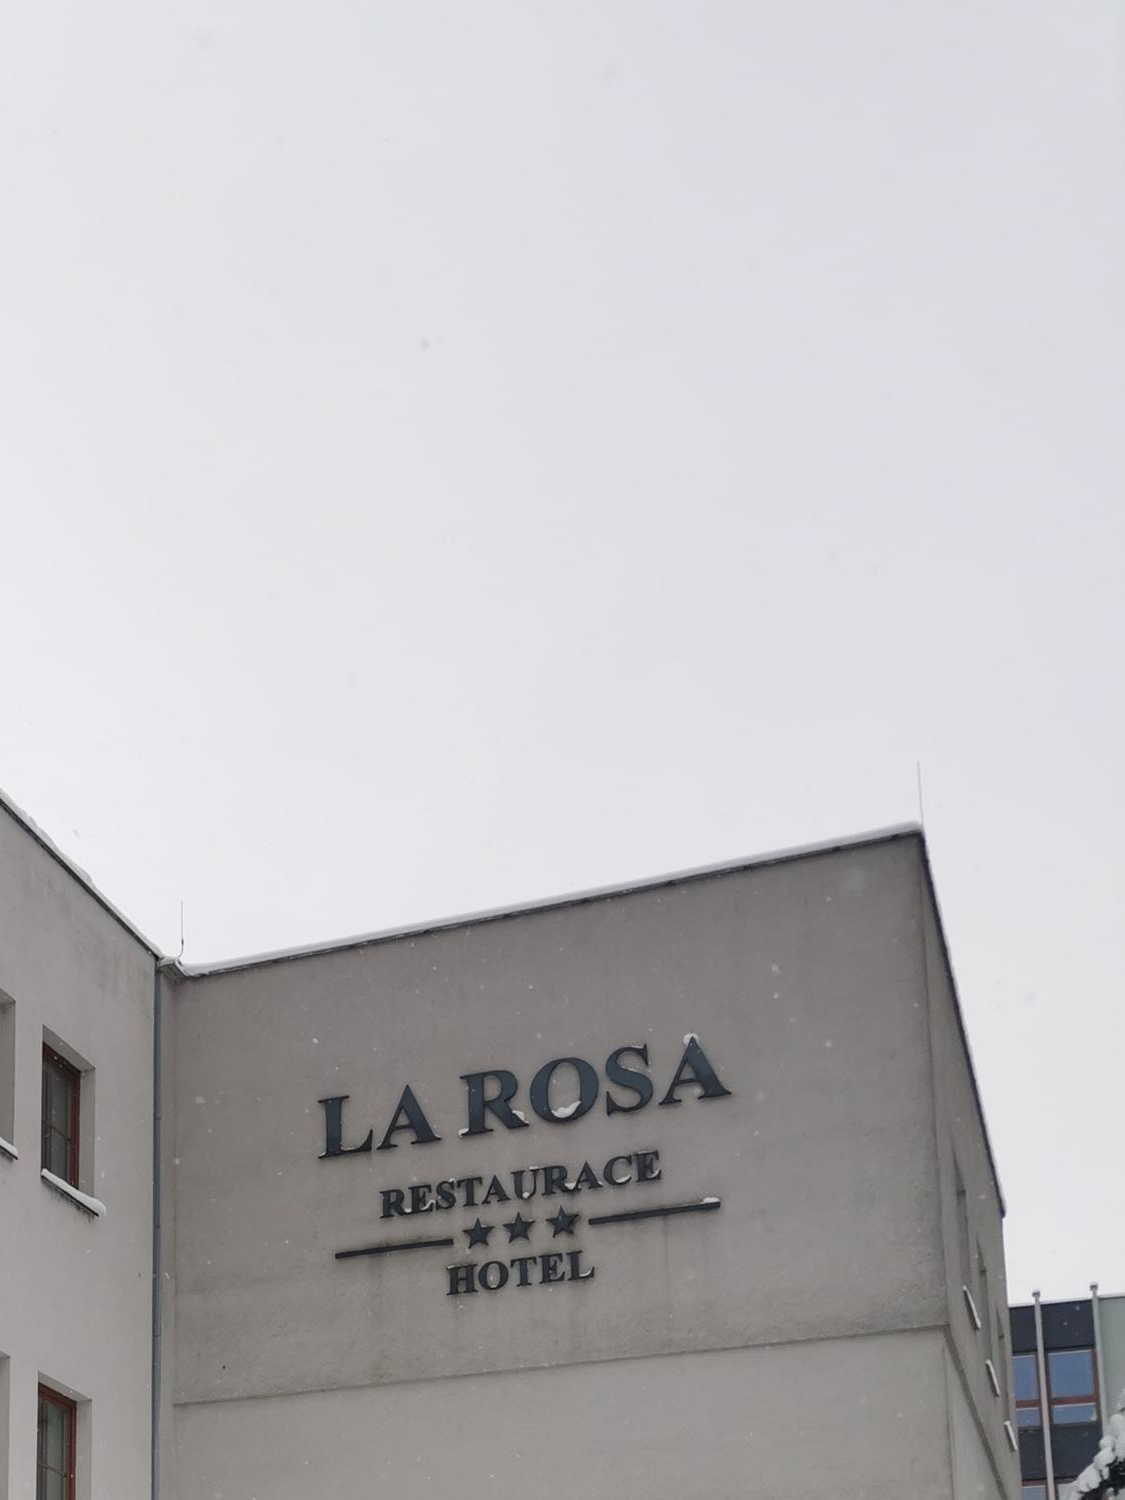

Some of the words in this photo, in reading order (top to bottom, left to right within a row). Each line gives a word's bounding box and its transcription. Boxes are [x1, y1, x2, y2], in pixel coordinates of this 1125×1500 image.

[317, 1084, 442, 1159] LA
[459, 1035, 732, 1137] ROSA
[380, 1150, 662, 1219] RESTAURACE
[446, 1250, 595, 1295] HOTEL
